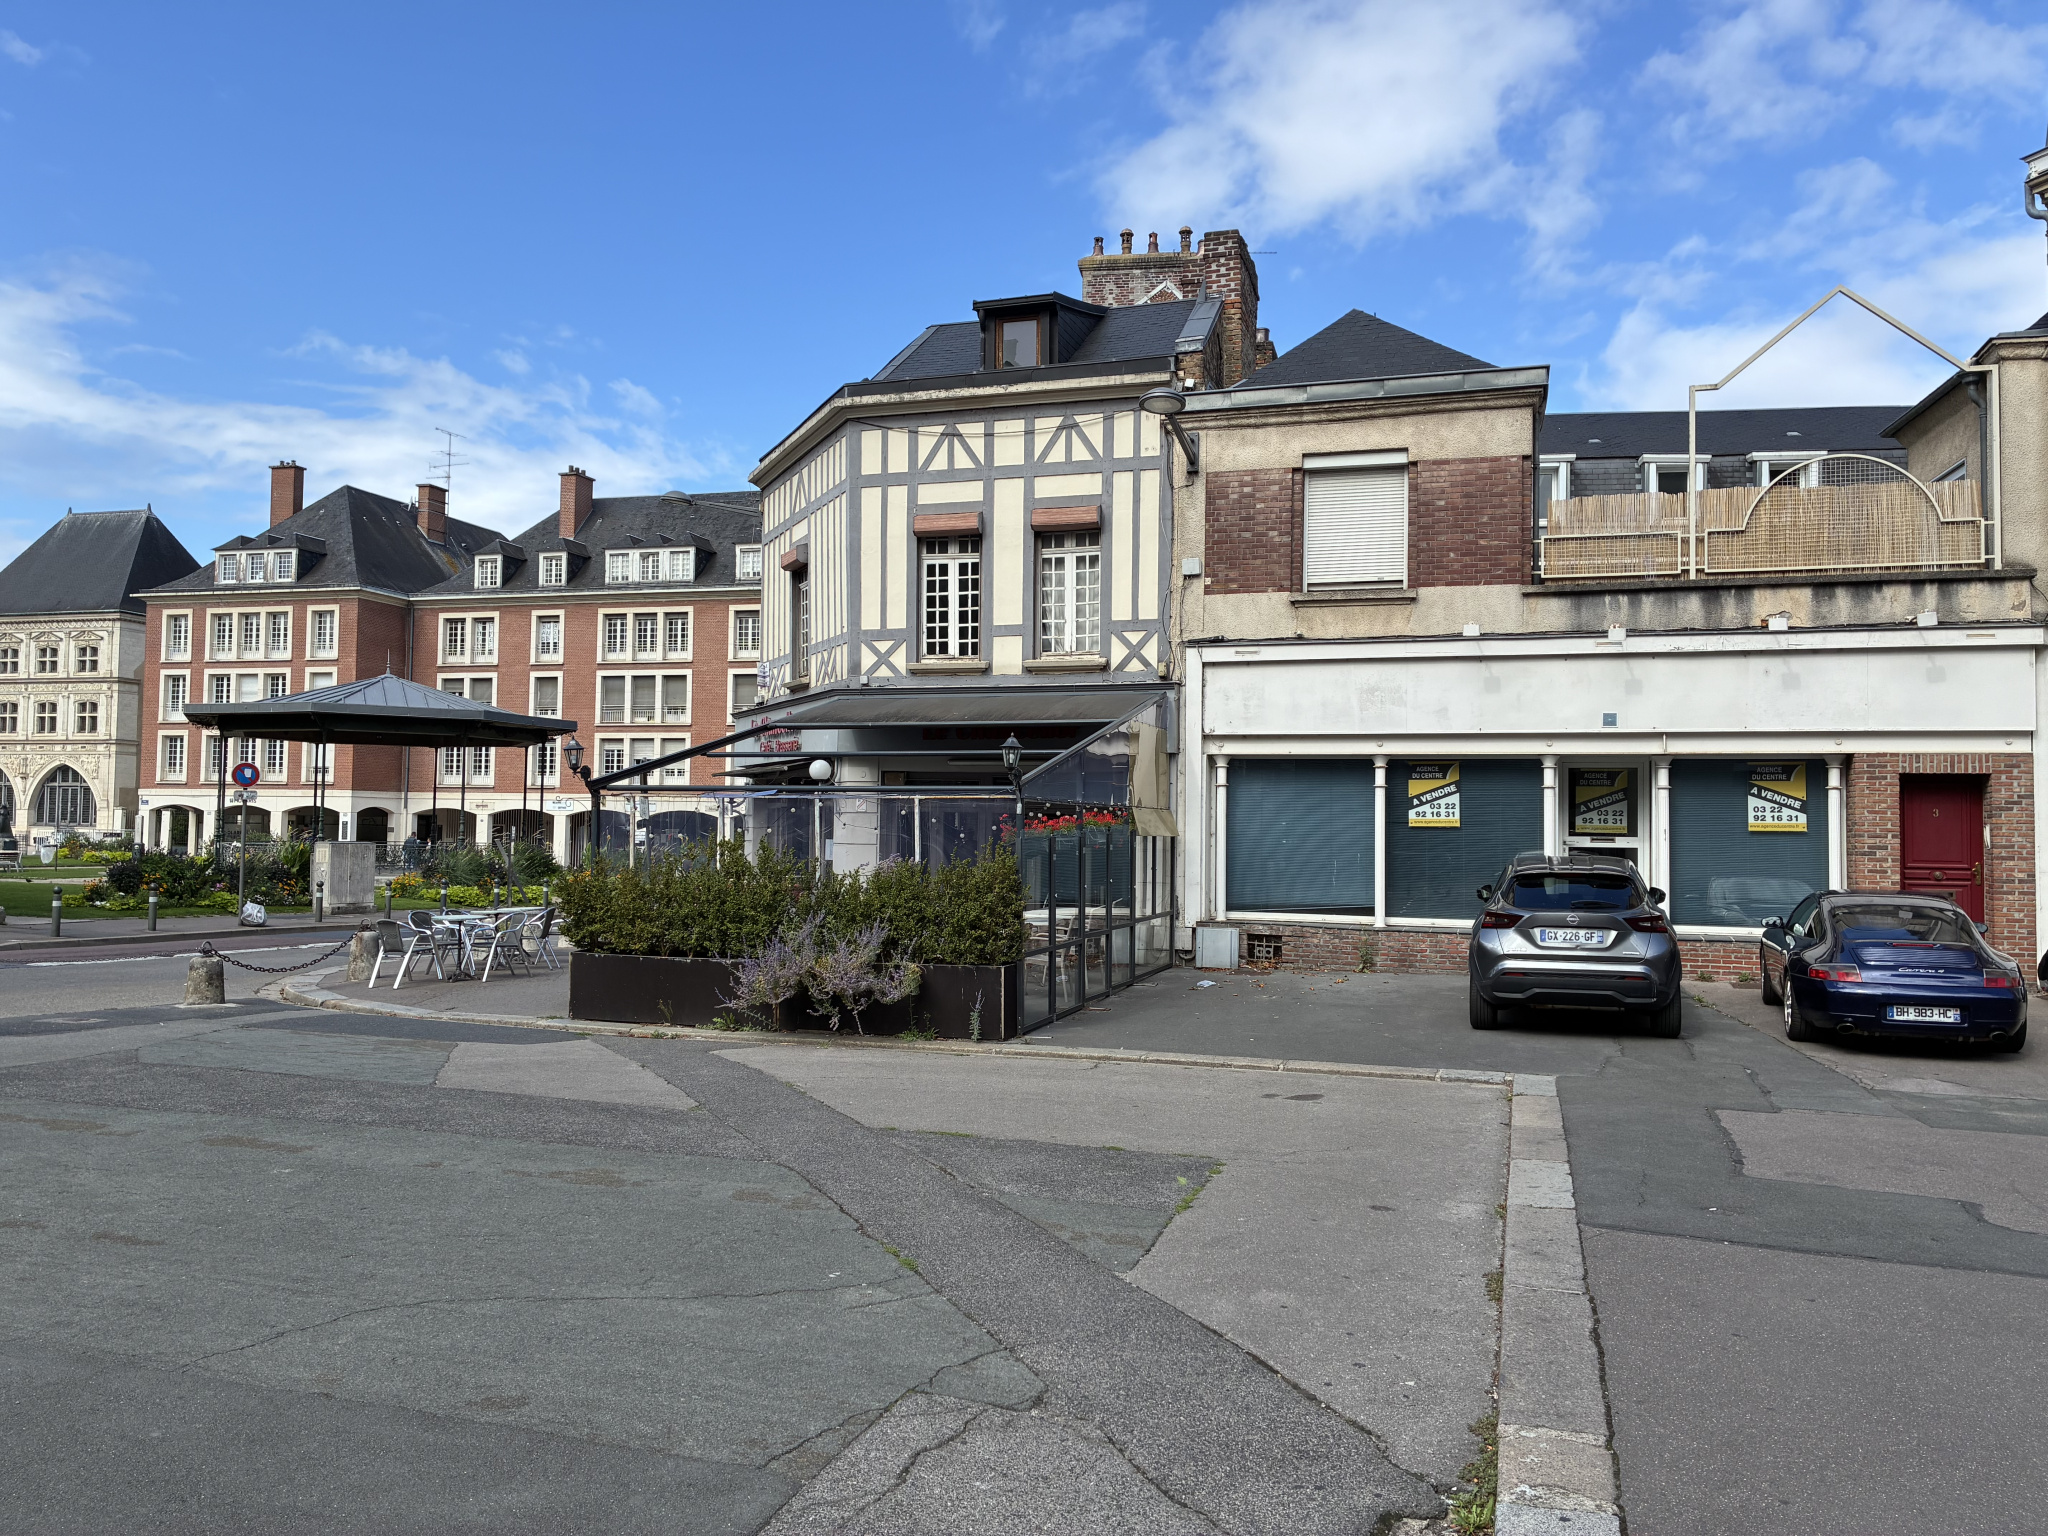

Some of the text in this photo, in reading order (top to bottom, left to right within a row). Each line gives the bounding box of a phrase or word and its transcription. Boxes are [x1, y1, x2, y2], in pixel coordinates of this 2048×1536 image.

[1413, 784, 1458, 806] A VENDRE
[1588, 791, 1626, 809] VENDRE
[1750, 786, 1802, 809] A VENDRE
[1932, 808, 1939, 817] 3
[1547, 931, 1596, 942] GX-226-GF
[1896, 1006, 1952, 1019] BH-983-HC
